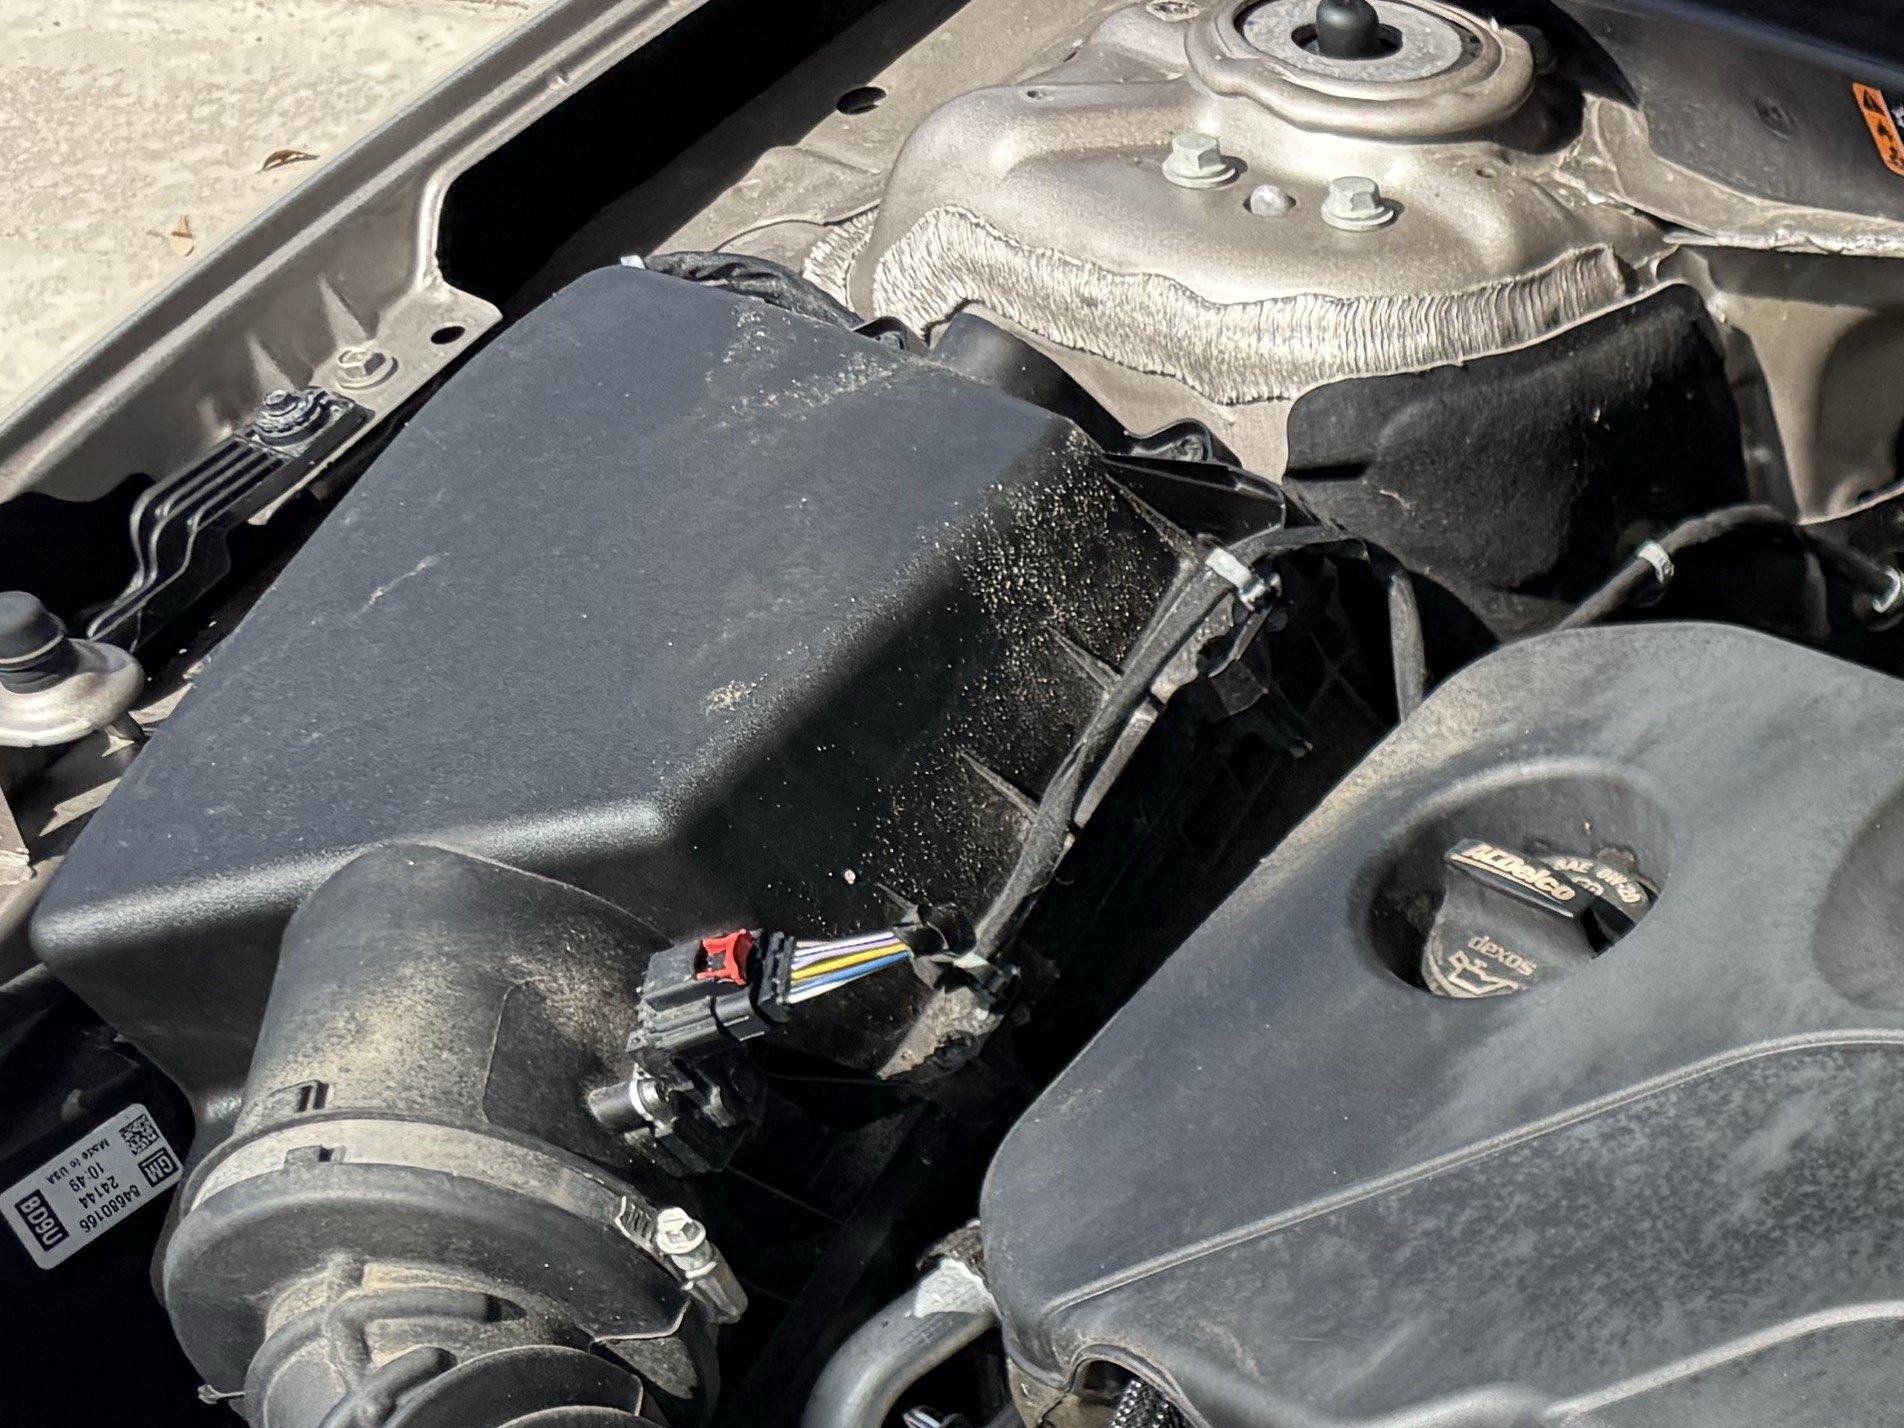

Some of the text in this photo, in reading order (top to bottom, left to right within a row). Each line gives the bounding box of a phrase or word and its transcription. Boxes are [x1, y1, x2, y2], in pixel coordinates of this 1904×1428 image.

[1459, 843, 1576, 901] ACDelco
[1553, 858, 1594, 874] SAE
[1467, 935, 1538, 977] dexos
[45, 1168, 69, 1185] USA
[141, 1151, 176, 1186] GM
[78, 1175, 119, 1209] 24144
